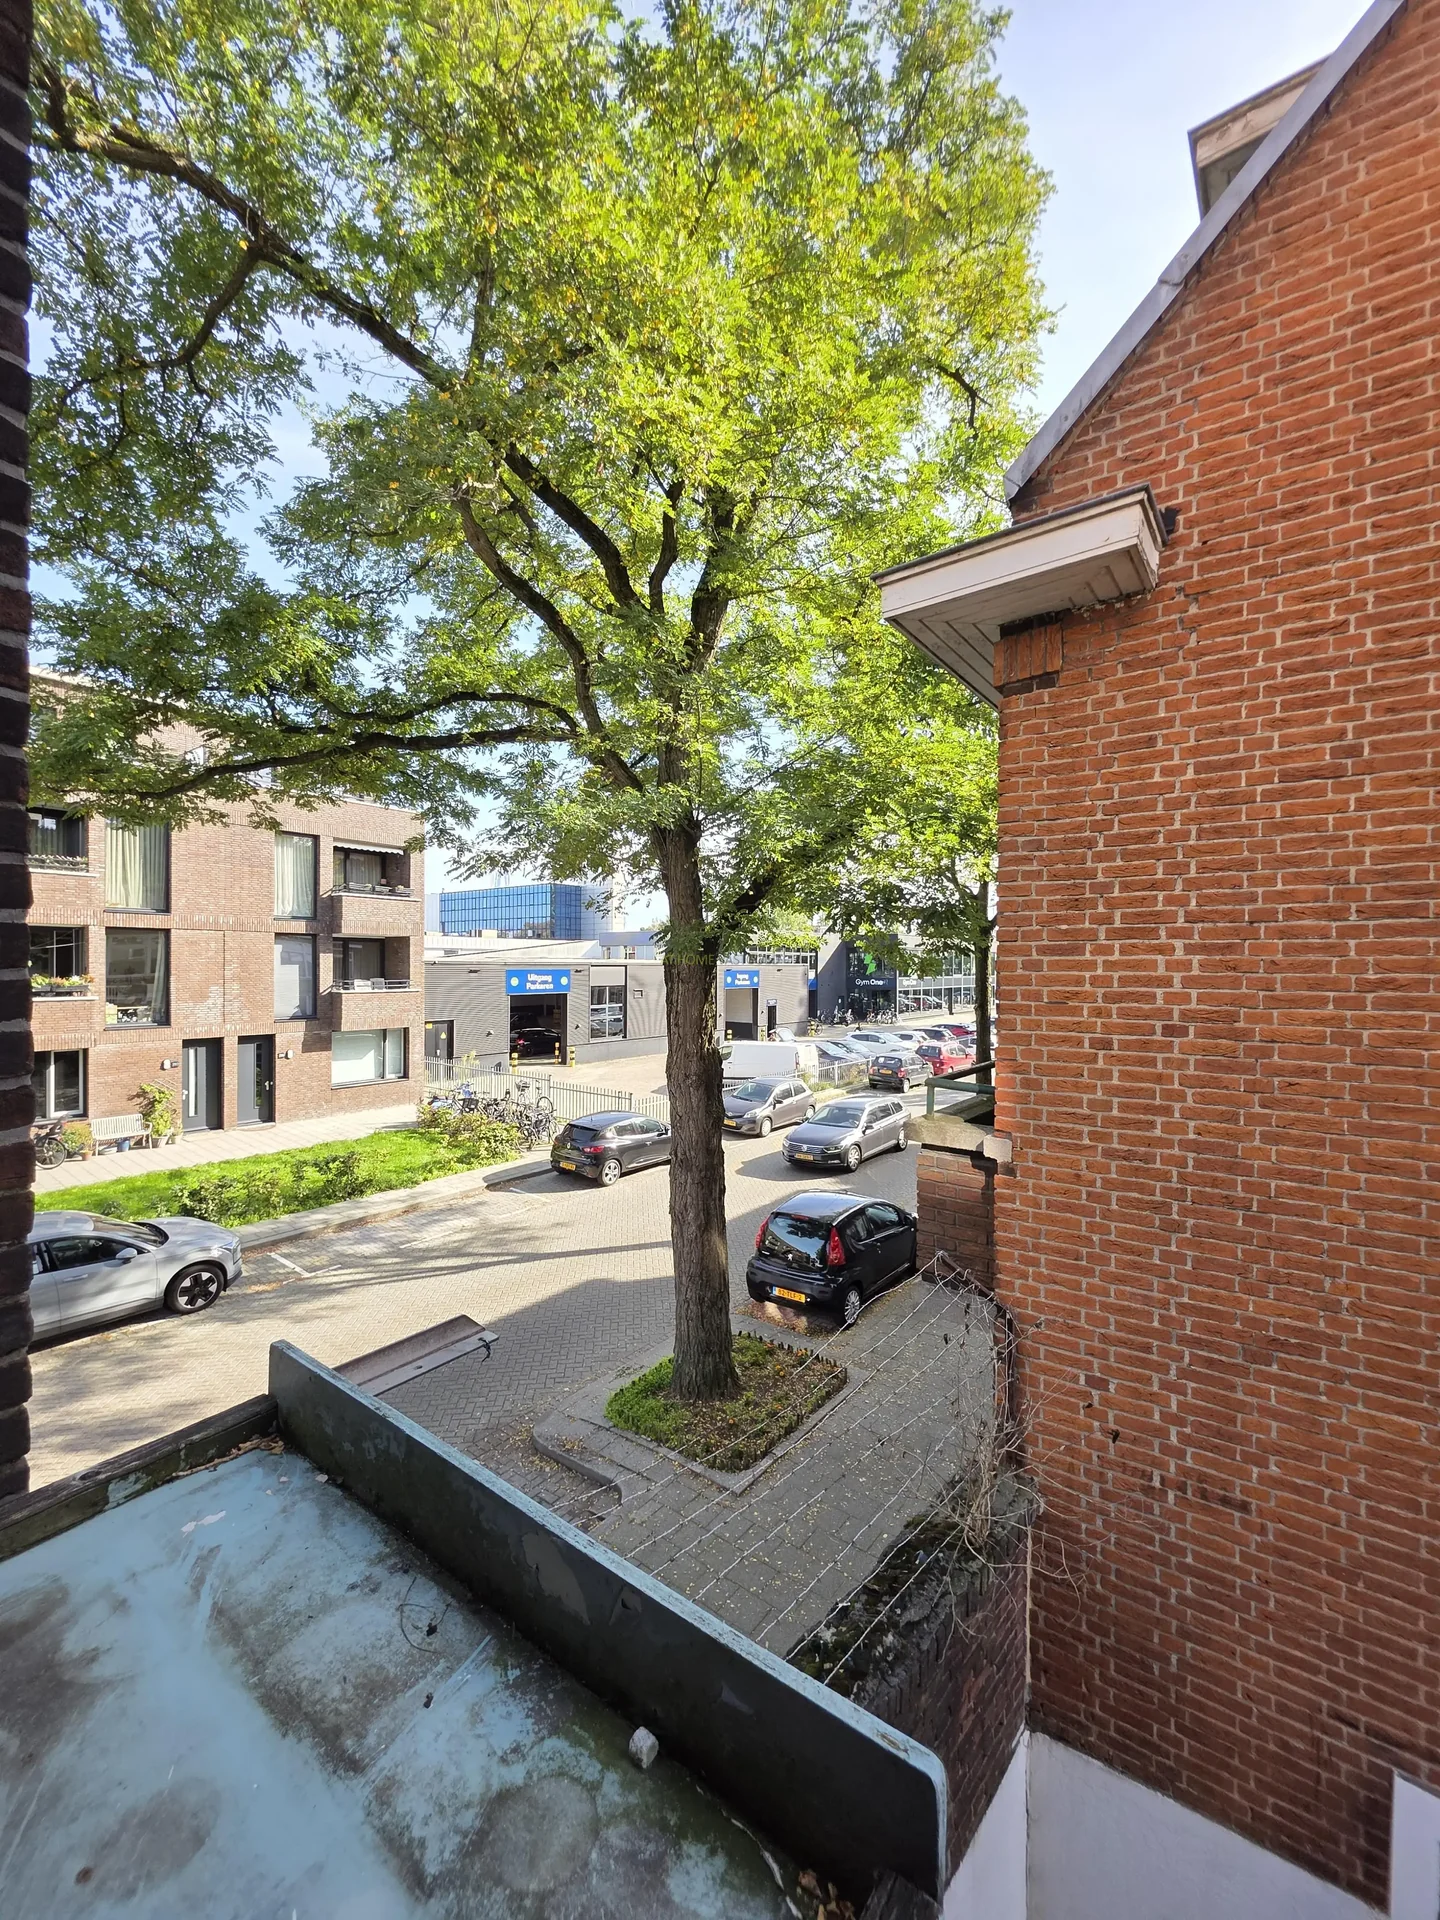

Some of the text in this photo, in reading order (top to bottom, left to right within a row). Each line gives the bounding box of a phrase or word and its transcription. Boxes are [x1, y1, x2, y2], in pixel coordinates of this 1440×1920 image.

[527, 973, 552, 983] Uitgang
[855, 978, 870, 987] Gym
[870, 978, 884, 986] One
